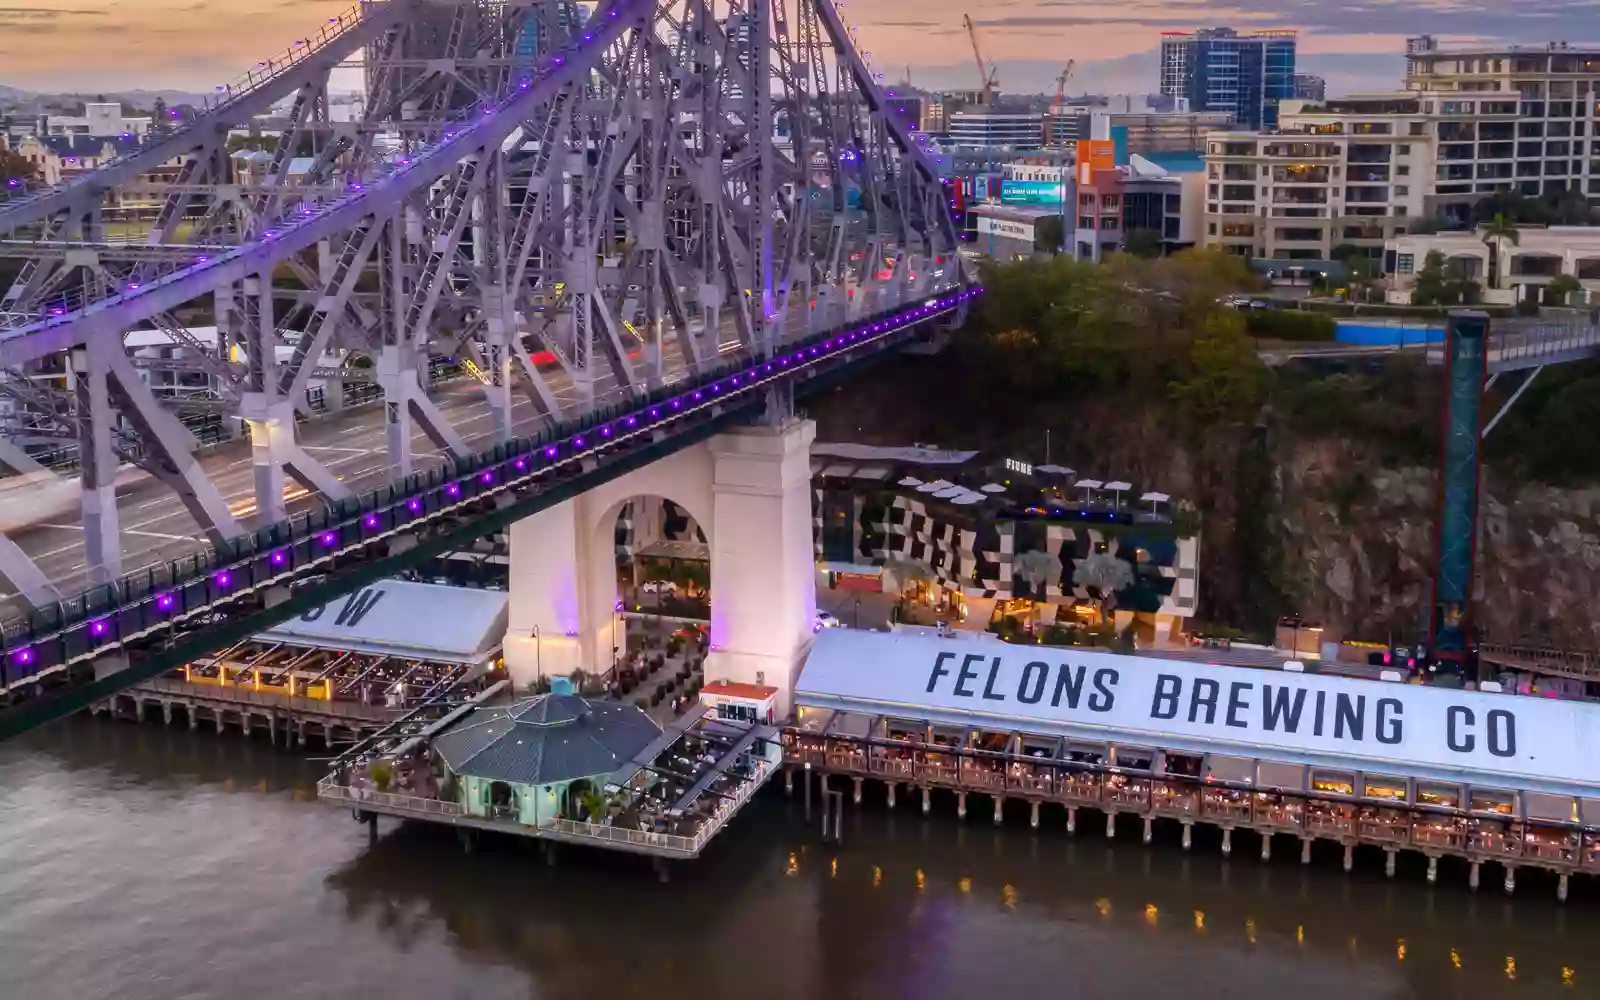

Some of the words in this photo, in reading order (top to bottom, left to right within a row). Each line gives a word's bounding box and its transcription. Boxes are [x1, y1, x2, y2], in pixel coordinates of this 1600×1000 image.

[1006, 458, 1032, 475] FIUME
[926, 651, 1120, 712] FELONS
[1150, 673, 1404, 744] BREWING
